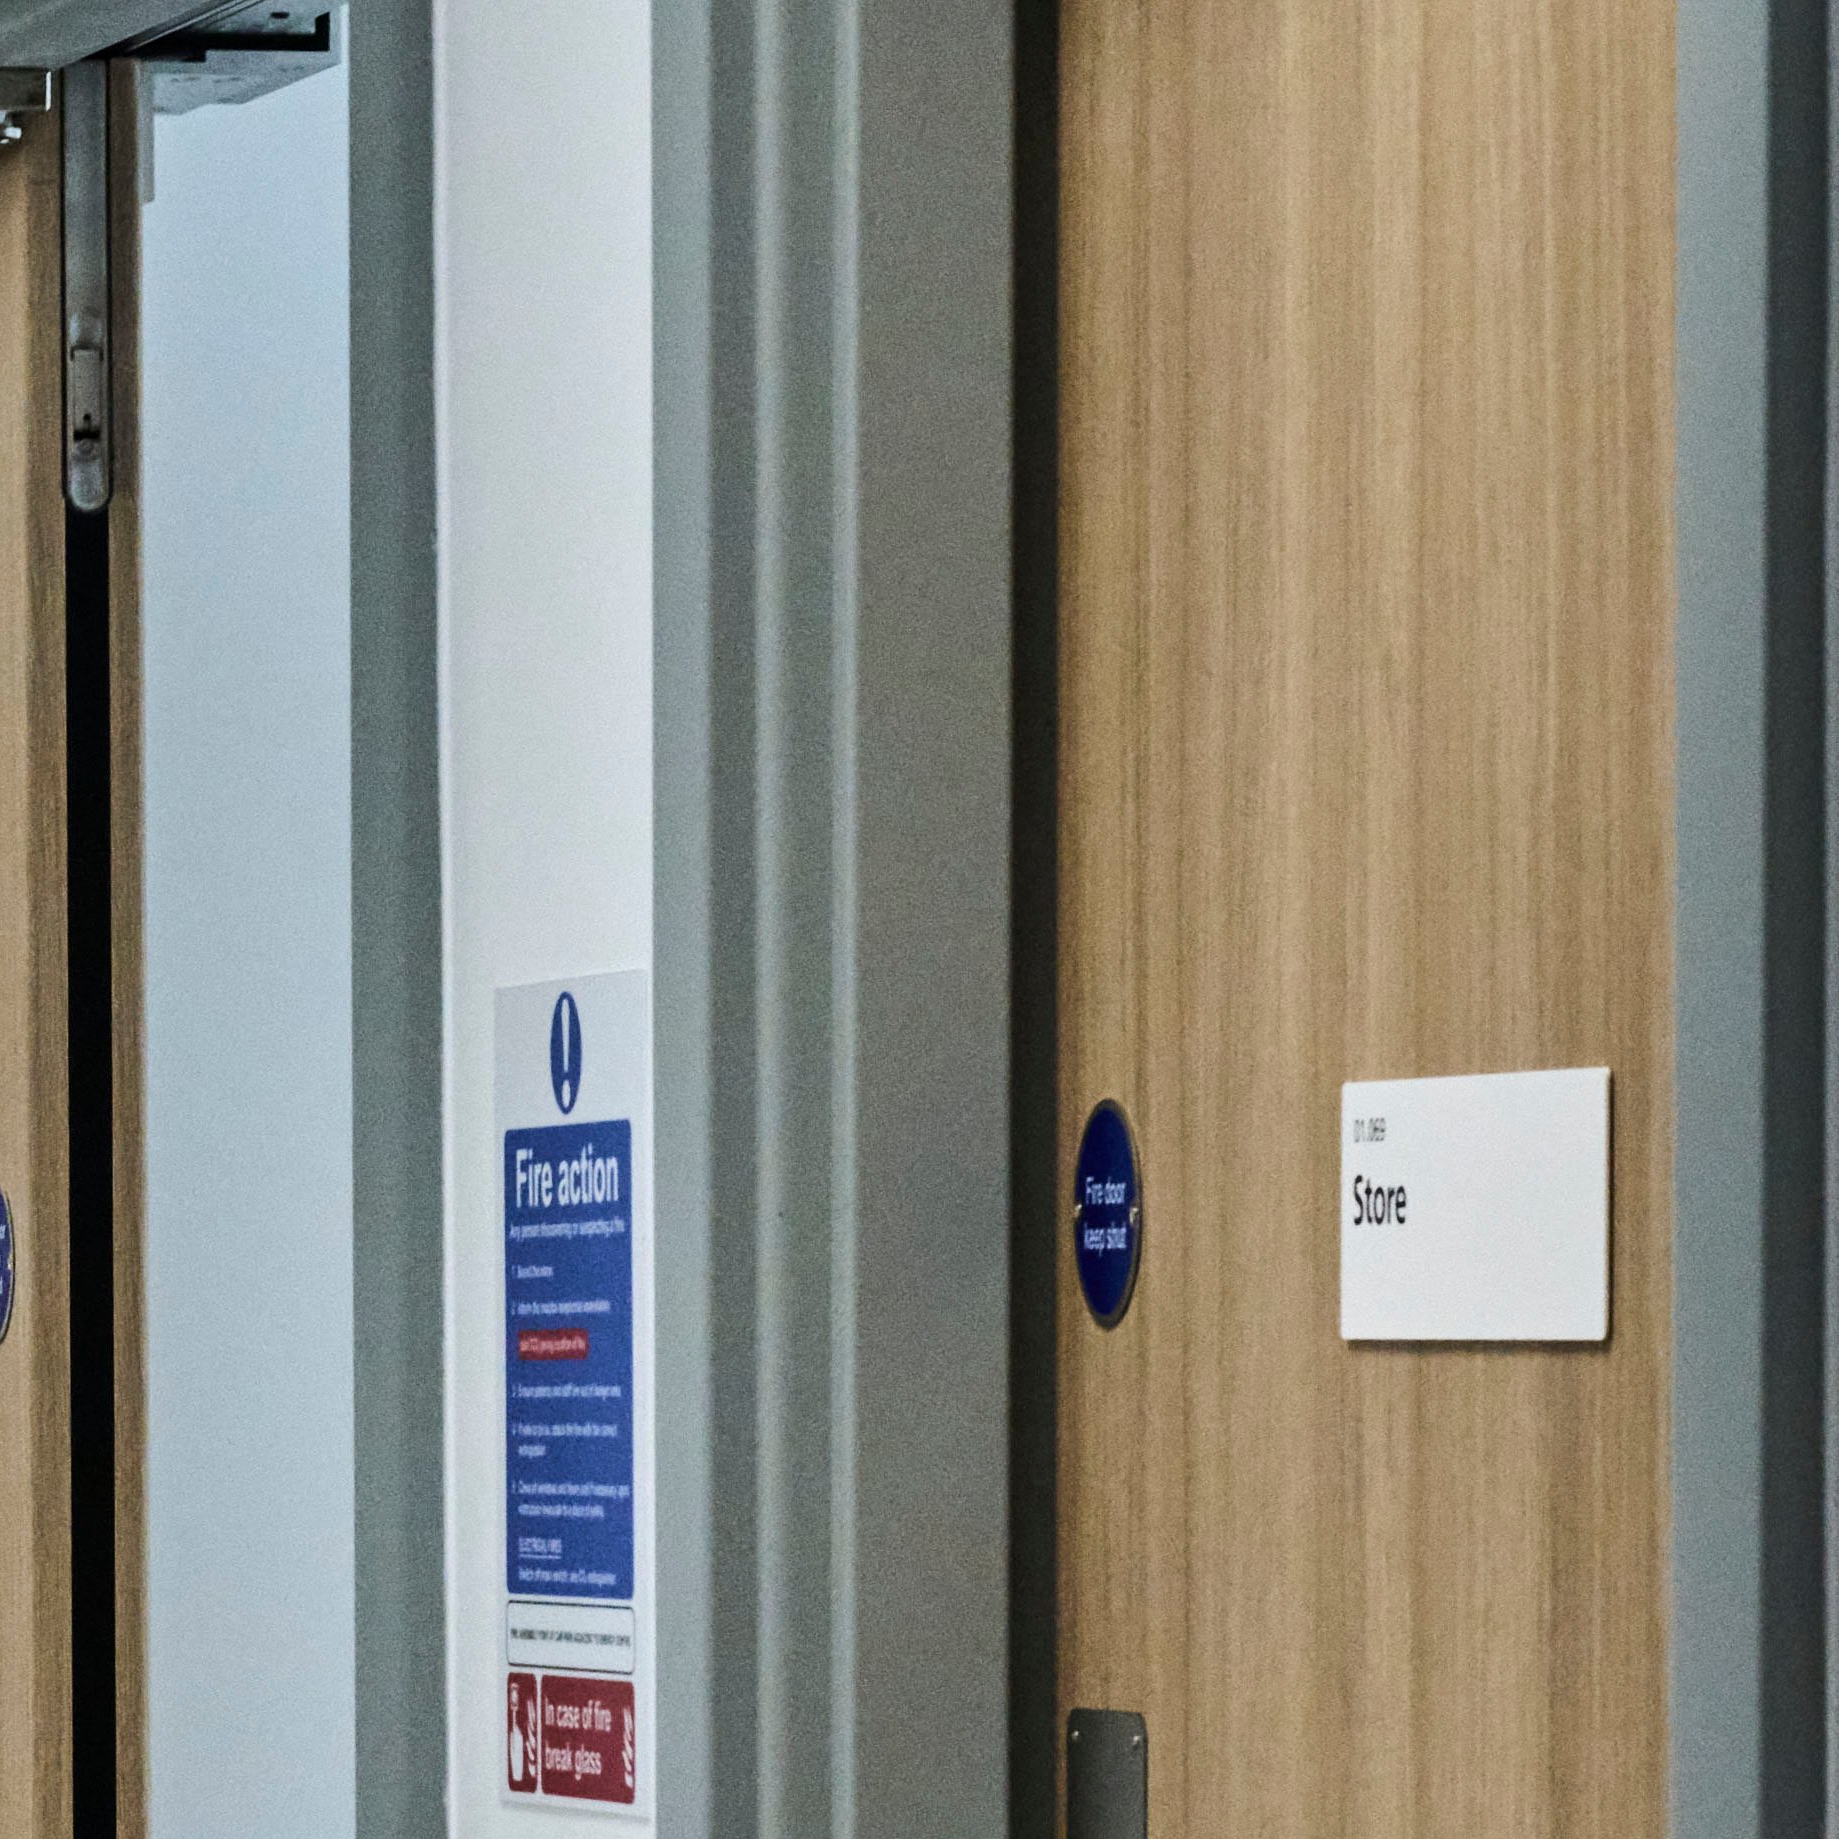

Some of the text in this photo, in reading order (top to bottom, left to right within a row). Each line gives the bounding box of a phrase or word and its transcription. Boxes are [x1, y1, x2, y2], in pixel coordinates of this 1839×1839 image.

[516, 1142, 619, 1208] Fire action
[1085, 1176, 1126, 1204] Fire door
[1353, 1174, 1407, 1225] Store
[1084, 1223, 1105, 1257] keep
[557, 1703, 579, 1729] case
[582, 1700, 593, 1730] of
[594, 1700, 611, 1732] fire
[545, 1741, 602, 1781] break glass
